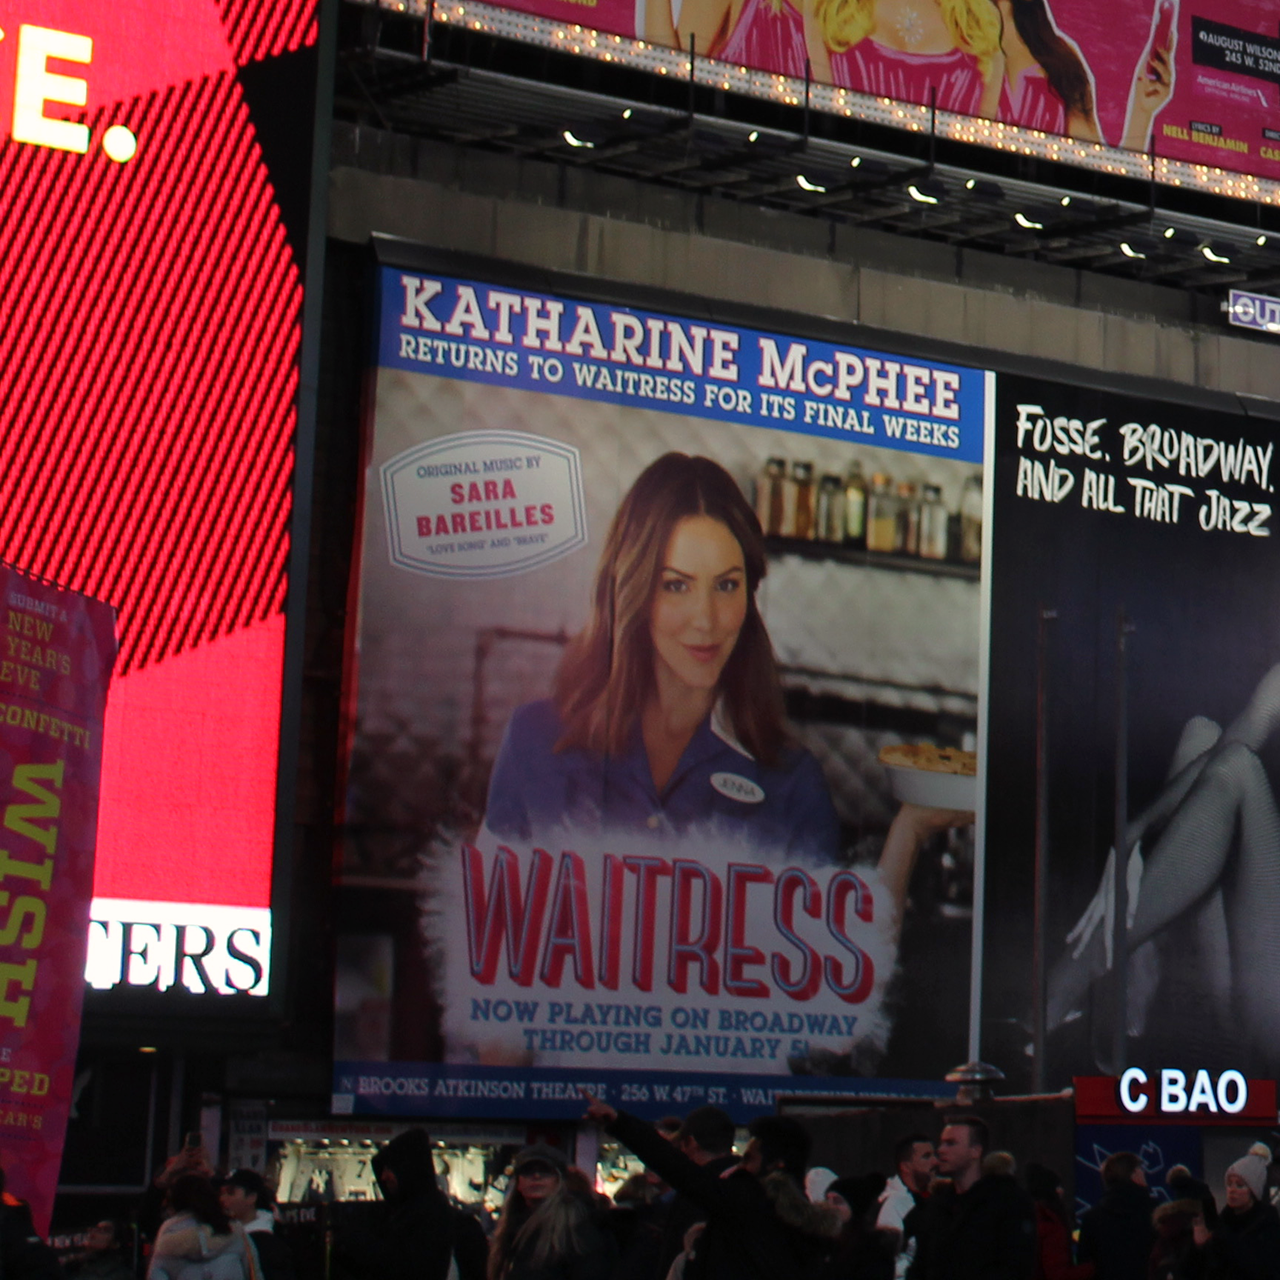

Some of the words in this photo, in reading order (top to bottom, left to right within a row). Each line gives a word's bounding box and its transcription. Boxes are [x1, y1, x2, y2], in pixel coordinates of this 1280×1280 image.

[1207, 32, 1243, 52] AUGUST
[1246, 42, 1280, 60] WILSON
[1225, 51, 1241, 64] 245
[1163, 123, 1189, 140] NELL
[1192, 129, 1248, 154] BENJAMIN
[399, 274, 740, 381] KATHARINE
[399, 332, 519, 378] RETURNS
[528, 353, 564, 384] TO
[572, 361, 696, 406] WAITRESS
[703, 383, 753, 415] FOR
[760, 393, 797, 421] ITS
[803, 400, 875, 435] FINAL
[881, 413, 961, 450] WEEKS
[1015, 403, 1111, 462] FOSSE.
[1118, 422, 1275, 494] BROADWAY.
[417, 461, 479, 479] ORIGINAL
[483, 458, 523, 473] MUSIC
[526, 456, 541, 468] BY
[450, 478, 516, 504] SARA
[1015, 455, 1075, 504] AND
[1081, 473, 1125, 515] ALL
[1126, 477, 1195, 524] THAT
[1198, 488, 1273, 537] JAZZ
[416, 502, 555, 538] BAREILLES
[8, 610, 54, 642] NEW
[7, 635, 71, 675] YEAR'S
[460, 844, 875, 1005] WAITRESS
[469, 998, 542, 1024] NOW
[547, 1002, 663, 1031] PLAYING
[670, 1006, 710, 1032] ON
[717, 1008, 859, 1038] BROADWAY
[523, 1028, 652, 1056] THROUGH
[661, 1032, 784, 1059] JANUARY
[357, 1076, 429, 1096] BROOKS
[433, 1079, 525, 1099] ATKINSON
[620, 1085, 650, 1102] 256
[1119, 1067, 1148, 1114] C
[1160, 1068, 1248, 1114] BAO
